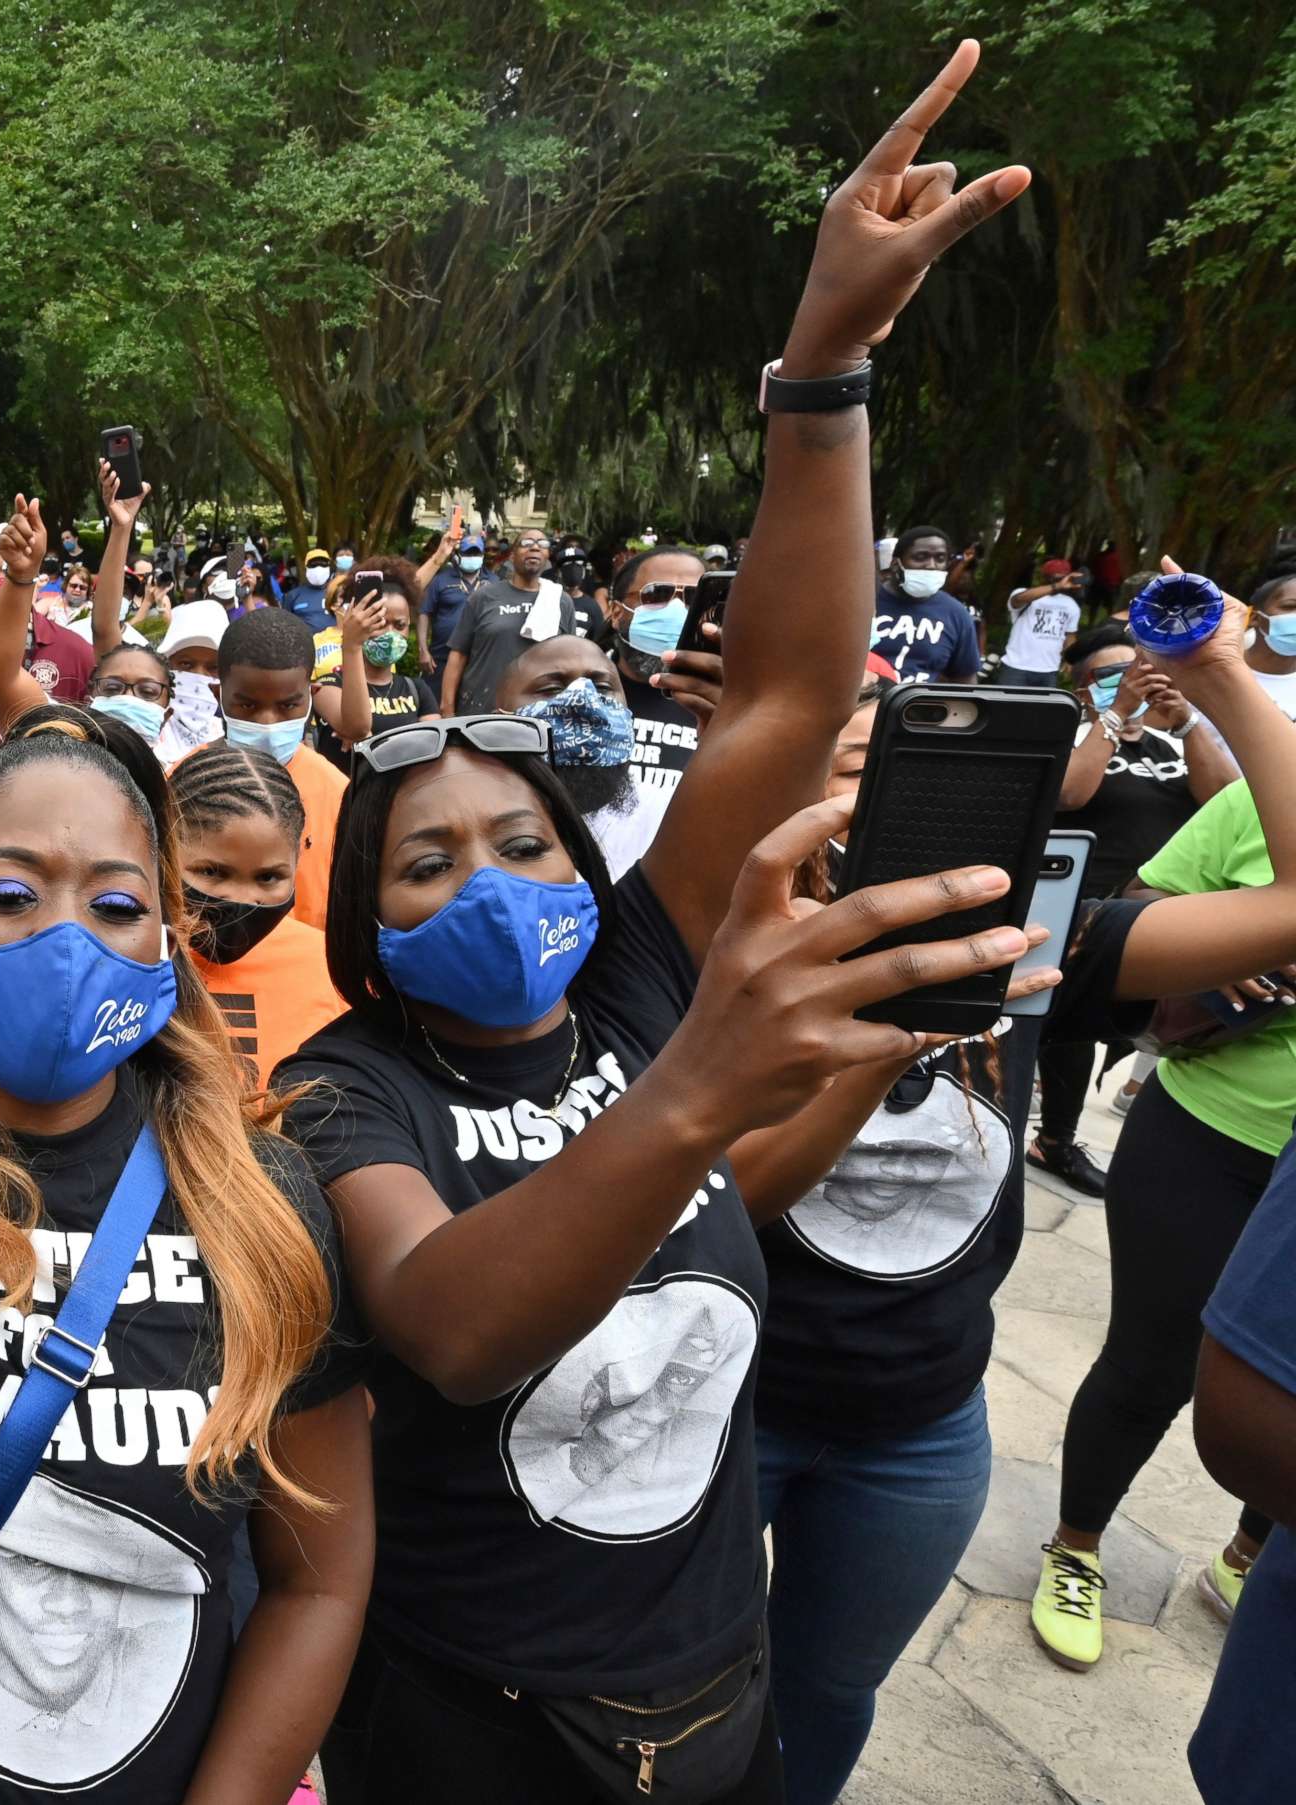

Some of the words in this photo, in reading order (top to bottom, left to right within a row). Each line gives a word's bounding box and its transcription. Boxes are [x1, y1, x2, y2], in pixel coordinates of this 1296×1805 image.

[499, 604, 521, 615] Not
[875, 614, 944, 645] CAN
[895, 645, 910, 670] I
[634, 718, 698, 750] TICE
[629, 743, 661, 765] OR
[114, 1023, 141, 1047] 1920
